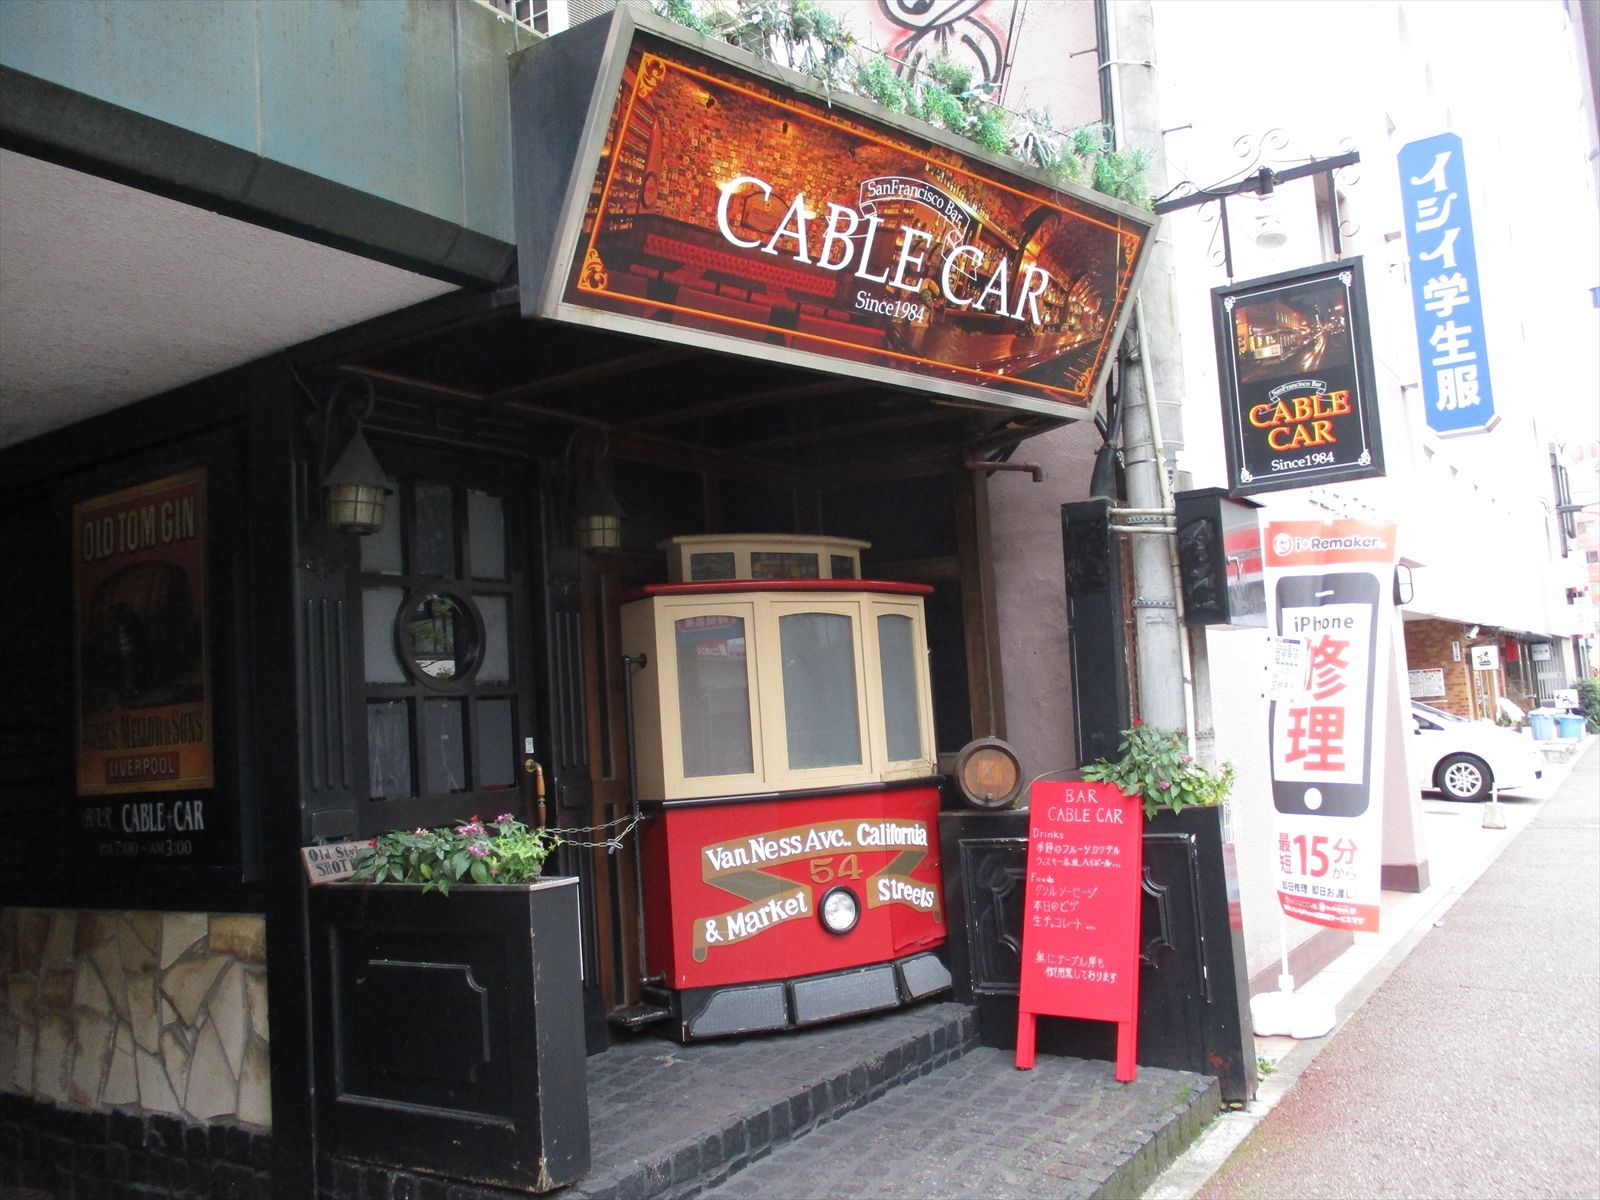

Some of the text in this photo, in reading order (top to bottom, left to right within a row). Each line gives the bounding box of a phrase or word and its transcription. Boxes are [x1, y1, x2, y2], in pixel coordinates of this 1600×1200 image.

[867, 180, 963, 223] SanFrancisco Bar
[717, 176, 1050, 325] CABLE CAR
[1410, 151, 1481, 411] イシイ学生服
[855, 291, 925, 323] Since1984
[1249, 389, 1351, 428] CABLE
[1268, 420, 1337, 451] CAR
[1271, 451, 1335, 471] Since1984
[83, 495, 195, 562] OLD TOM GIN
[1294, 616, 1354, 632] iPhone
[1285, 634, 1350, 771] 修理
[110, 757, 176, 777] LIVERPOOL
[1065, 789, 1098, 803] BAR
[122, 802, 167, 833] CABLE
[174, 800, 205, 832] CAR
[1048, 806, 1124, 824] CABLE CAR
[1033, 828, 1064, 839] Drinks
[308, 848, 331, 862] Old
[316, 860, 348, 877] SHOT
[705, 847, 750, 871] Van
[748, 835, 803, 862] Ness
[810, 853, 864, 885] 54
[1293, 834, 1330, 878] 15
[878, 878, 934, 908] Streets
[705, 891, 808, 943] & Market
